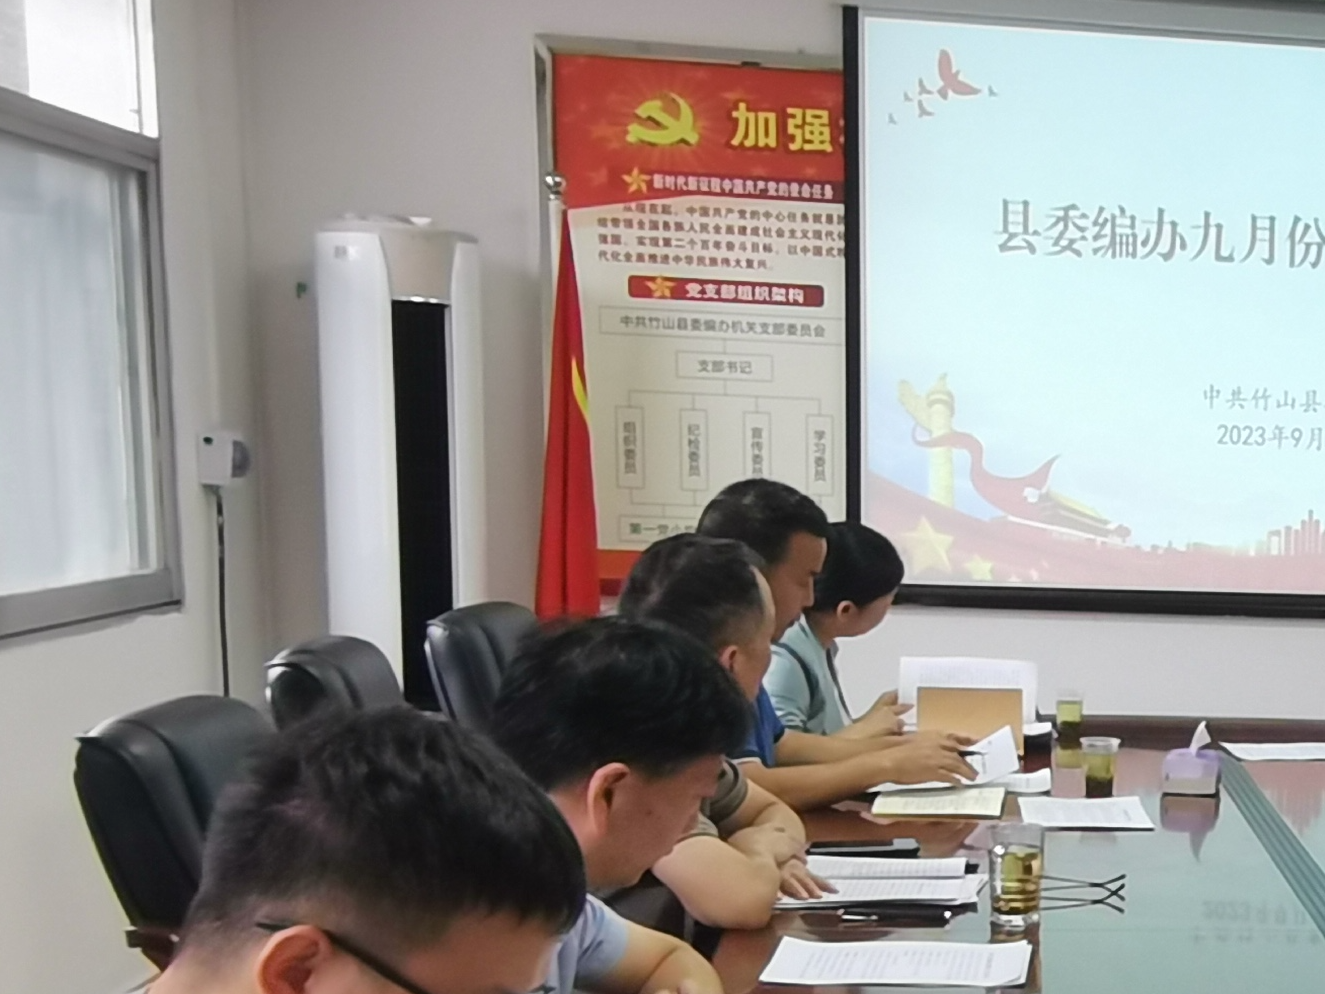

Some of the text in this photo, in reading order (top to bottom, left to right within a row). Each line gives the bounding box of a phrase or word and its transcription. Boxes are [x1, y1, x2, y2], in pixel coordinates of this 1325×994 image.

[685, 282, 804, 304] 党支部组织架构
[698, 360, 752, 375] 支部书记
